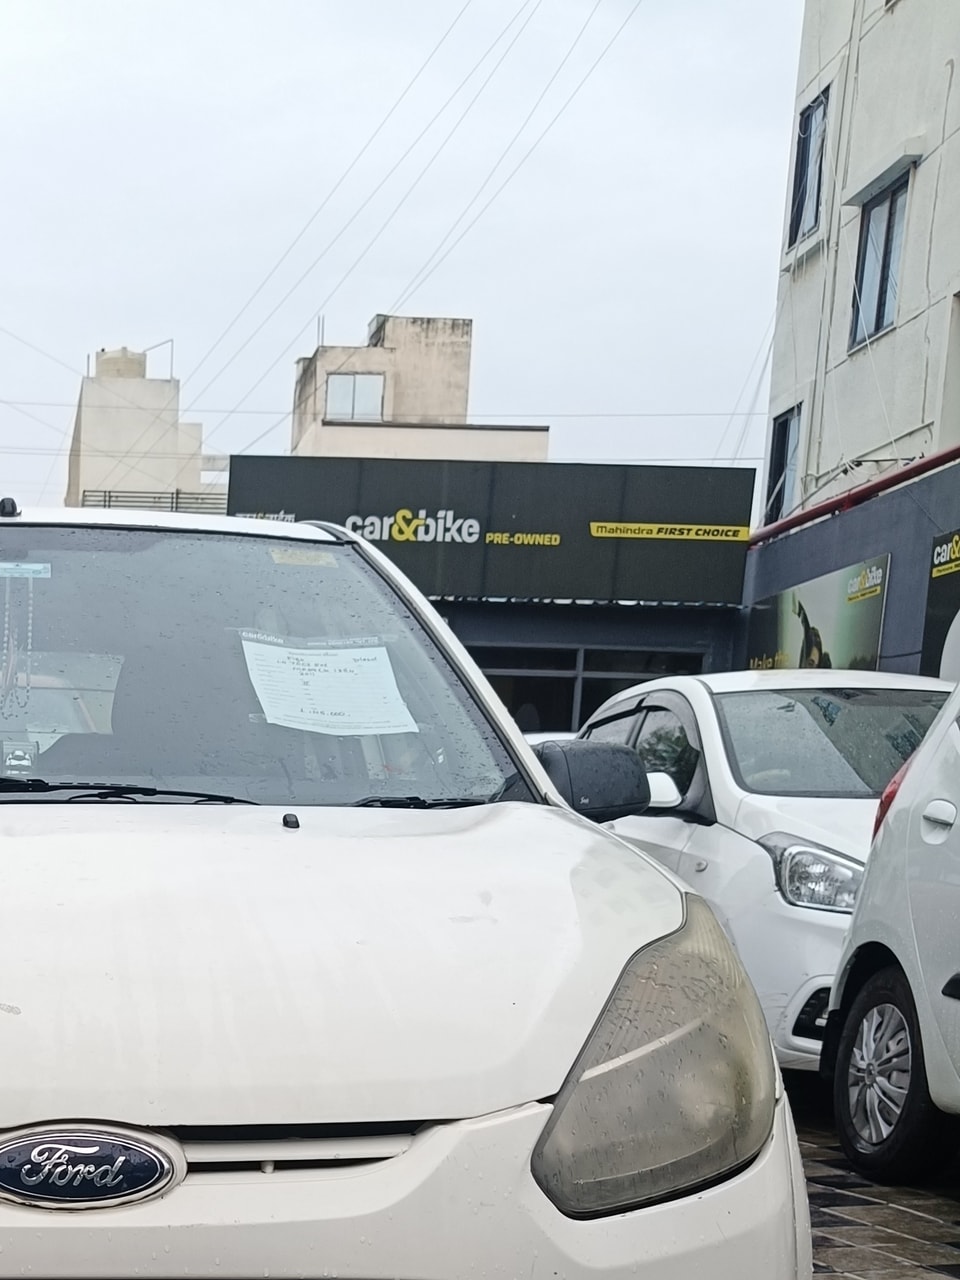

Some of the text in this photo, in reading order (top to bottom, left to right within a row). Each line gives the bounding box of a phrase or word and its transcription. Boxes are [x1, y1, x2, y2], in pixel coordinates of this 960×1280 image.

[345, 509, 561, 546] car&bike PRE-OWNED
[596, 525, 740, 538] Mahindra FIRST CHOICE
[21, 1144, 126, 1187] Ford
